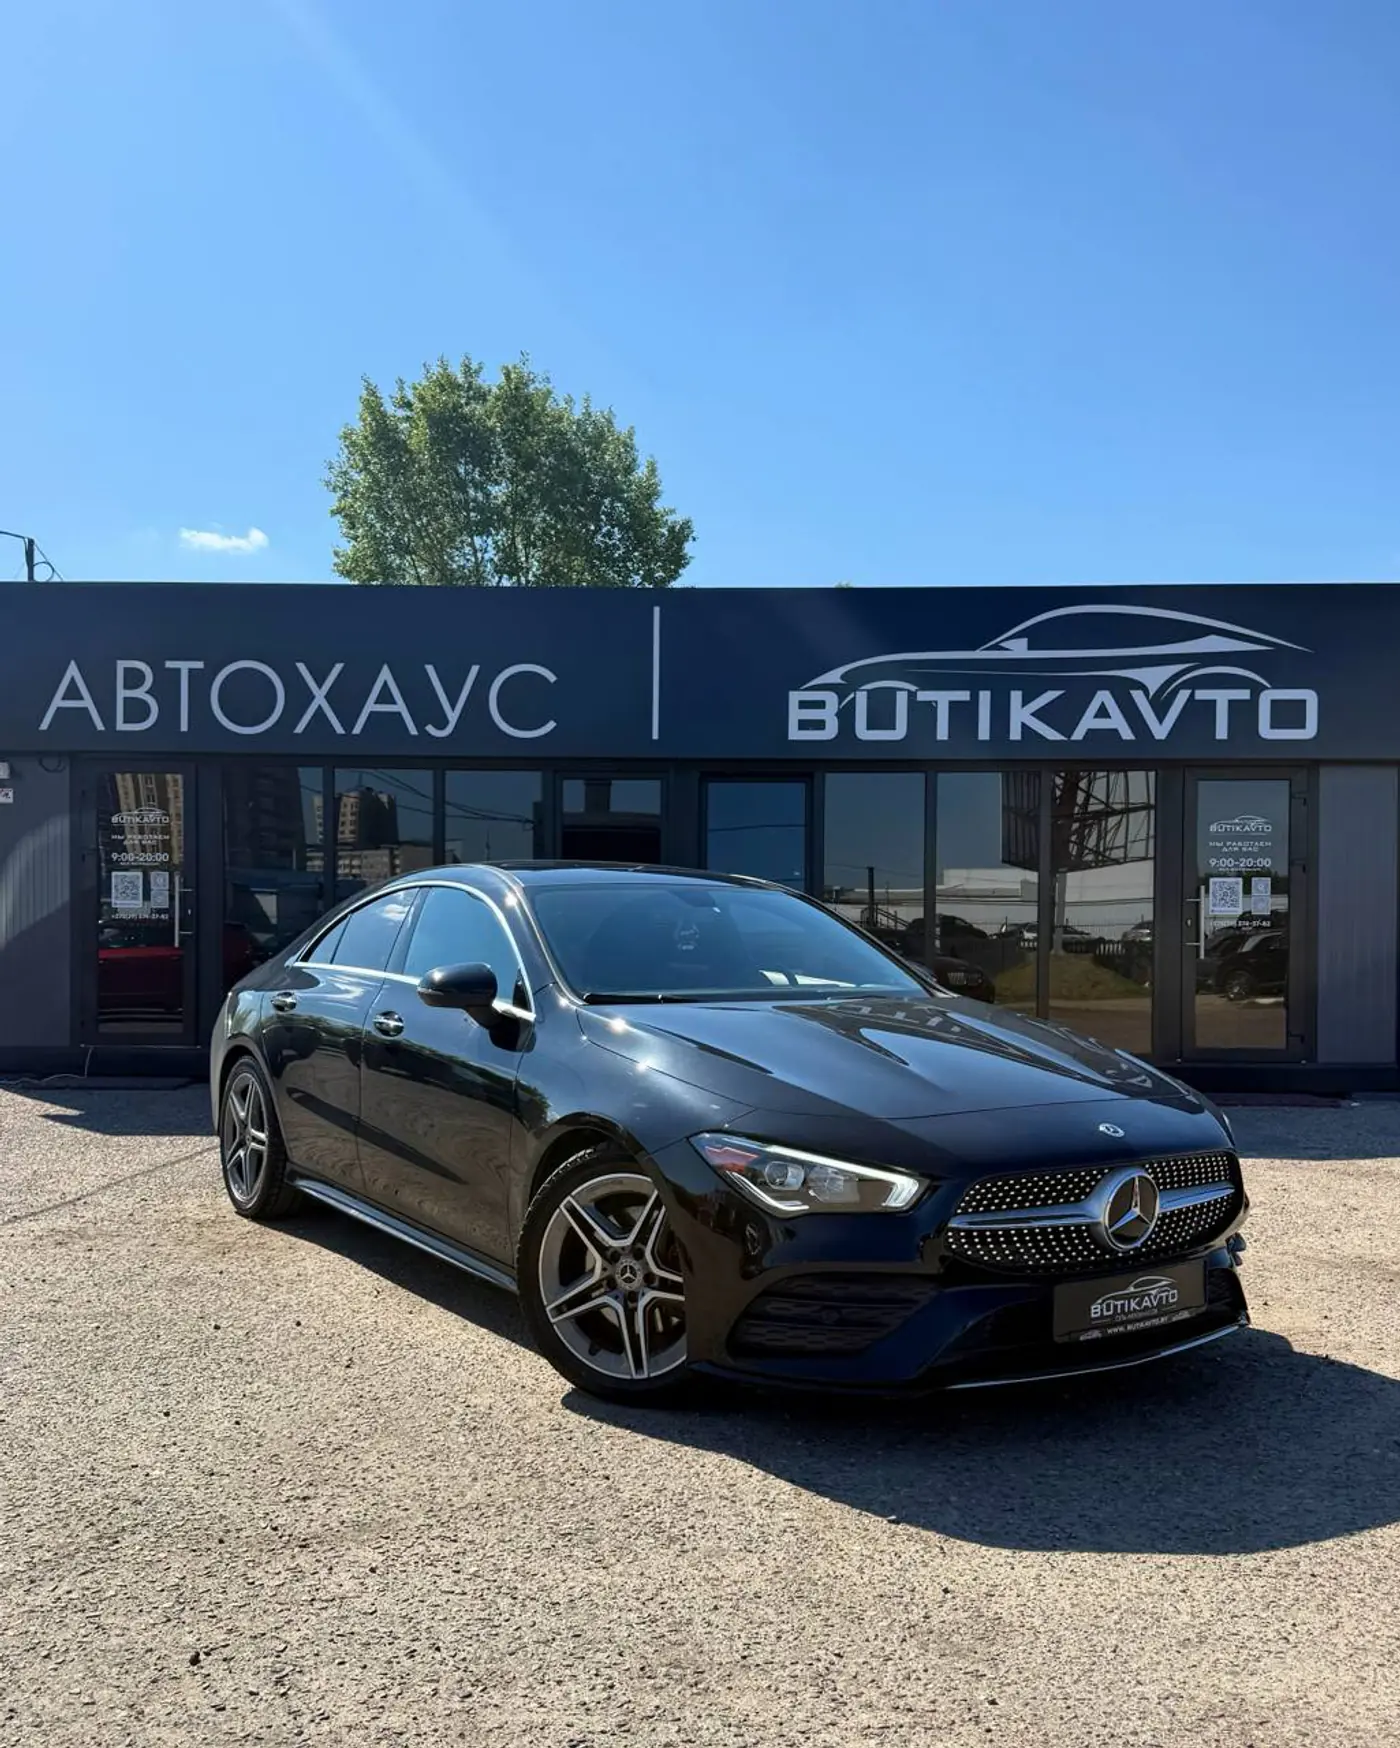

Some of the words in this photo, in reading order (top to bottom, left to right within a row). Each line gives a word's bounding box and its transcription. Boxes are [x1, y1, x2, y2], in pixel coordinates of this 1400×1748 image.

[38, 659, 558, 739] АВТОХАУС
[787, 688, 1319, 741] BUTIKAVTO
[1209, 824, 1272, 832] BUTIKAVTO
[111, 852, 170, 862] 9:00-20:00
[1208, 858, 1272, 868] 9:00-20:00
[1090, 1289, 1178, 1318] BUTIKAVTO
